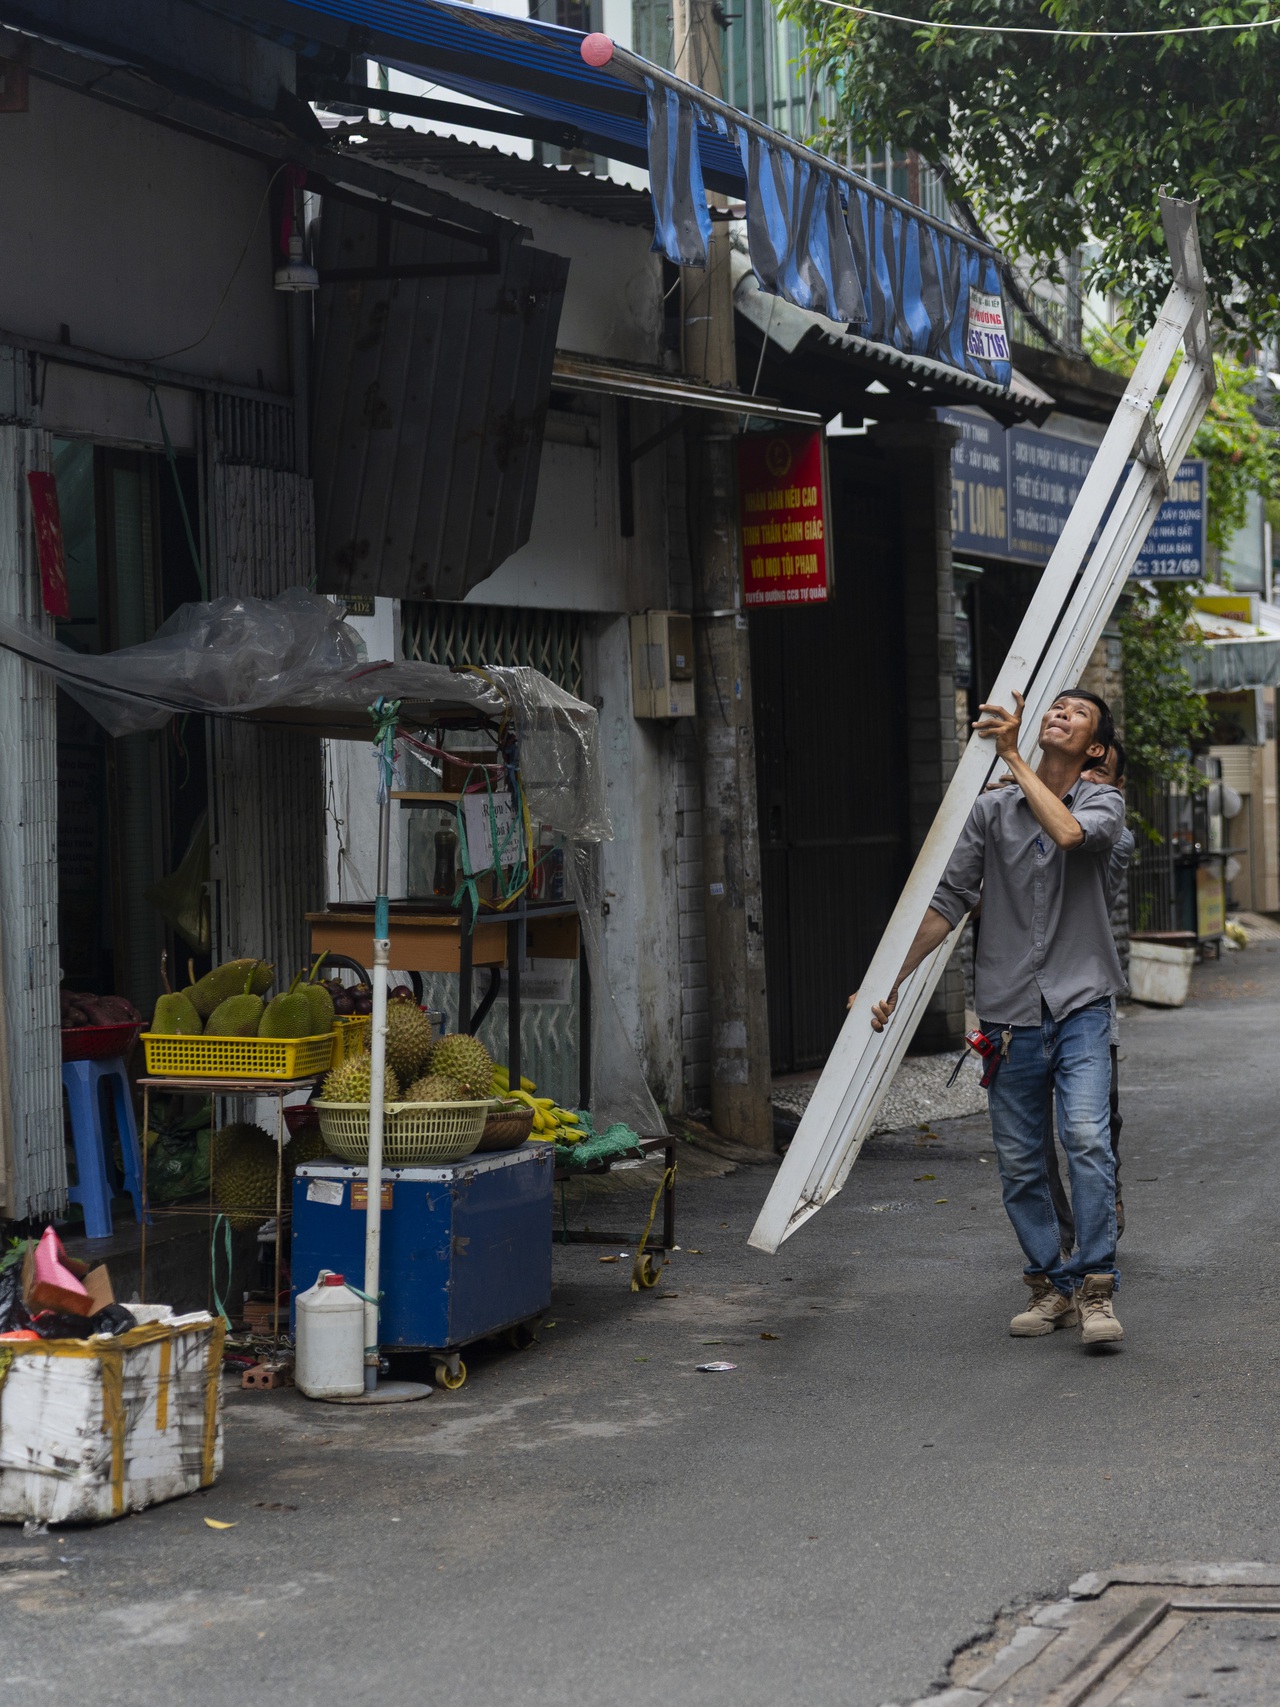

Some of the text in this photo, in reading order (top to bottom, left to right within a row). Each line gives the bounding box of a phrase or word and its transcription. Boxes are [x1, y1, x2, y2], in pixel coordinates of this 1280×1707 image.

[984, 333, 1009, 358] 7161
[802, 486, 817, 507] CAO
[1164, 481, 1200, 503] ONG
[969, 482, 1005, 538] LONG
[743, 525, 760, 546] TINH
[782, 516, 803, 542] CẢNH
[804, 515, 823, 540] GIÁC
[765, 556, 780, 581] MỌI
[781, 552, 794, 580] TỘI
[795, 553, 818, 579] PHẠM
[1130, 559, 1200, 575] C: 312/69
[786, 589, 799, 600] CCB
